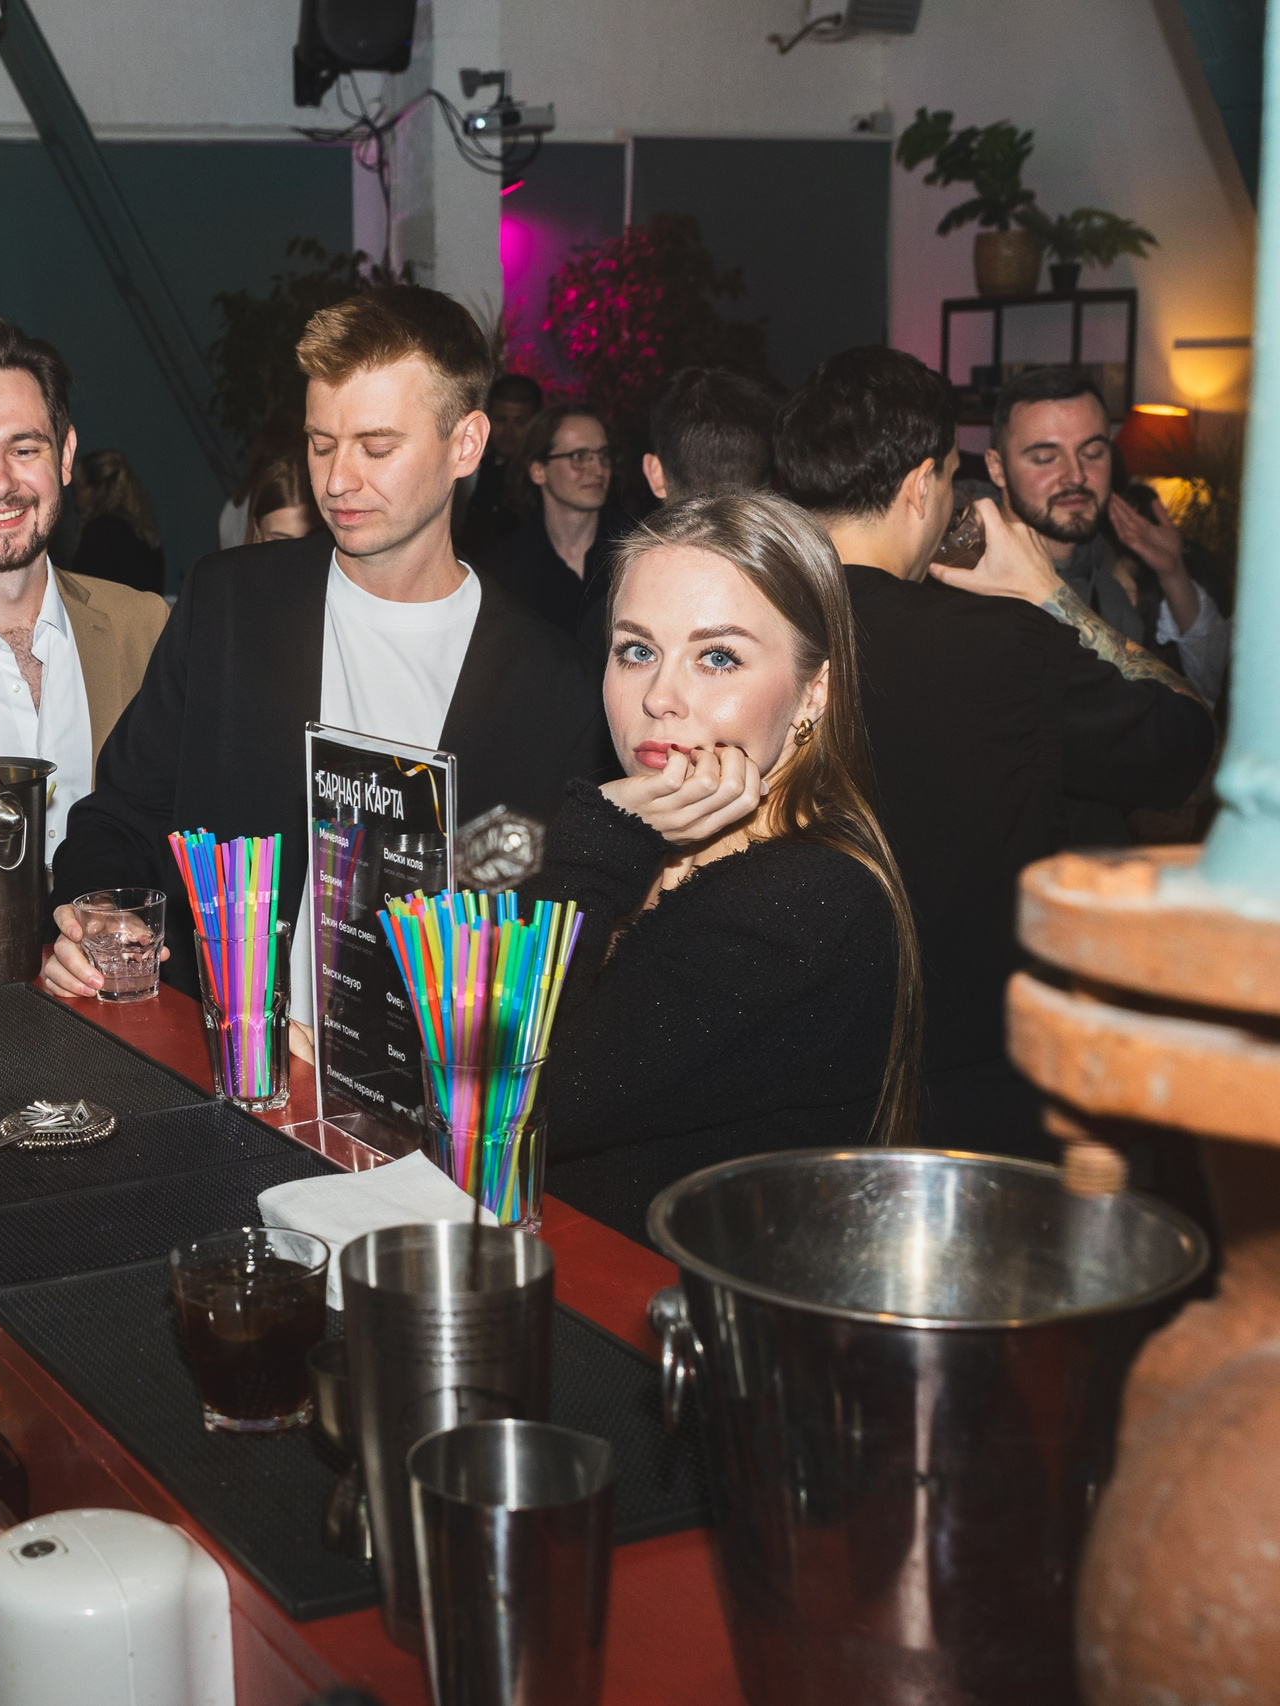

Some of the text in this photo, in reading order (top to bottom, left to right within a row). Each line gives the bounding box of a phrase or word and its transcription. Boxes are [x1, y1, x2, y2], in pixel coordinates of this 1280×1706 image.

[317, 770, 405, 821] БАРНАЯ КАРТА
[319, 827, 350, 848] Мичелада
[383, 847, 406, 866] Виски
[406, 857, 424, 871] кола
[320, 870, 343, 888] Белини
[321, 912, 338, 929] Джин
[358, 929, 377, 944] смеш
[322, 963, 362, 991] Виски сауэр
[324, 1014, 360, 1041] Джин тоник
[387, 1043, 406, 1062] Вино
[326, 1064, 354, 1090] Лимонад
[354, 1081, 385, 1104] маракуйя
